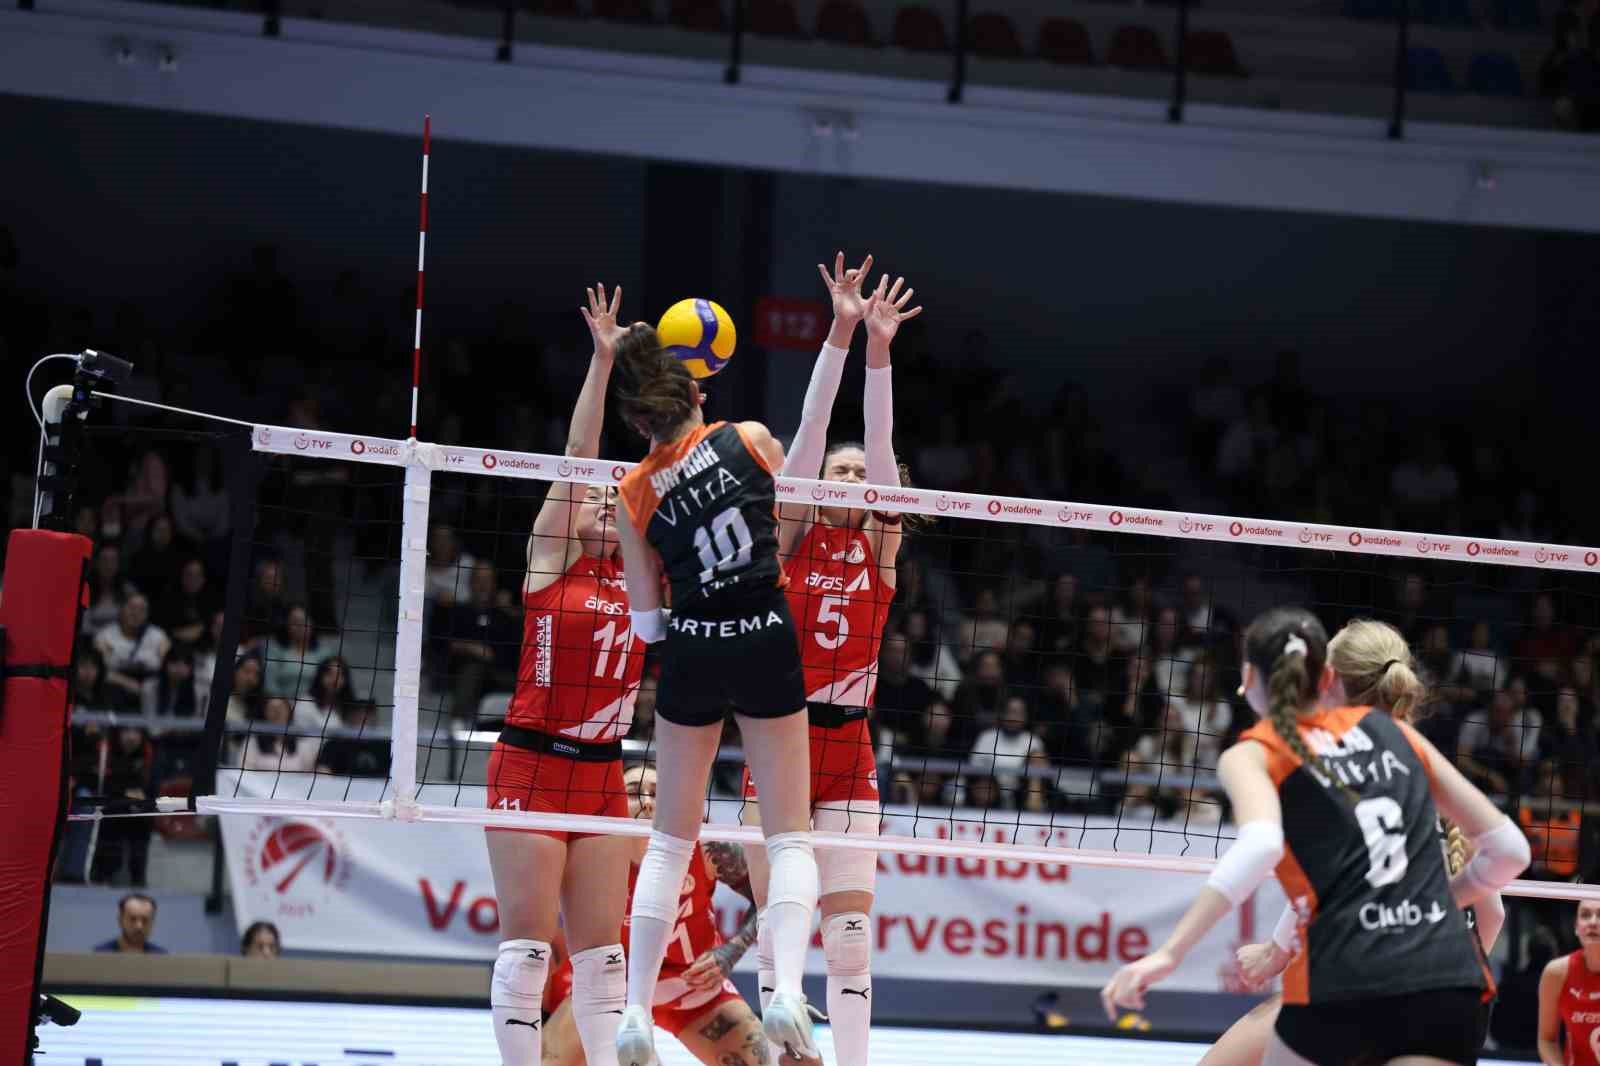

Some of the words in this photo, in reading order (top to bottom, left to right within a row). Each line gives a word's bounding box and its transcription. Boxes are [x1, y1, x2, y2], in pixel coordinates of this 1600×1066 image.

[311, 439, 335, 450] TVF
[367, 445, 399, 456] vodafo
[499, 459, 541, 471] vodafone
[573, 466, 595, 477] TVF
[776, 484, 796, 495] fone
[828, 489, 848, 500] TVF
[880, 494, 920, 505] vodafone
[951, 501, 972, 512] TVF
[1003, 504, 1042, 516] vodafone
[1073, 511, 1094, 522] TVF
[1125, 517, 1163, 527] vodafone
[1193, 522, 1216, 533] TVF
[1244, 526, 1283, 537] vodafone
[1313, 532, 1335, 543] TVF
[1363, 537, 1402, 546] vodafone
[1431, 542, 1452, 552] TVF
[1481, 547, 1520, 557] vodafone
[1549, 552, 1569, 562] TVF
[655, 466, 742, 527] VitrA
[693, 507, 754, 584] 10
[584, 596, 625, 615] aras
[805, 571, 844, 591] aras
[593, 620, 634, 681] 11
[670, 610, 783, 638] ARTEMA
[814, 594, 850, 649] 5
[499, 797, 521, 811] 11
[876, 821, 1072, 884] ulübü
[1355, 797, 1408, 888] 6
[1359, 899, 1422, 930] Club
